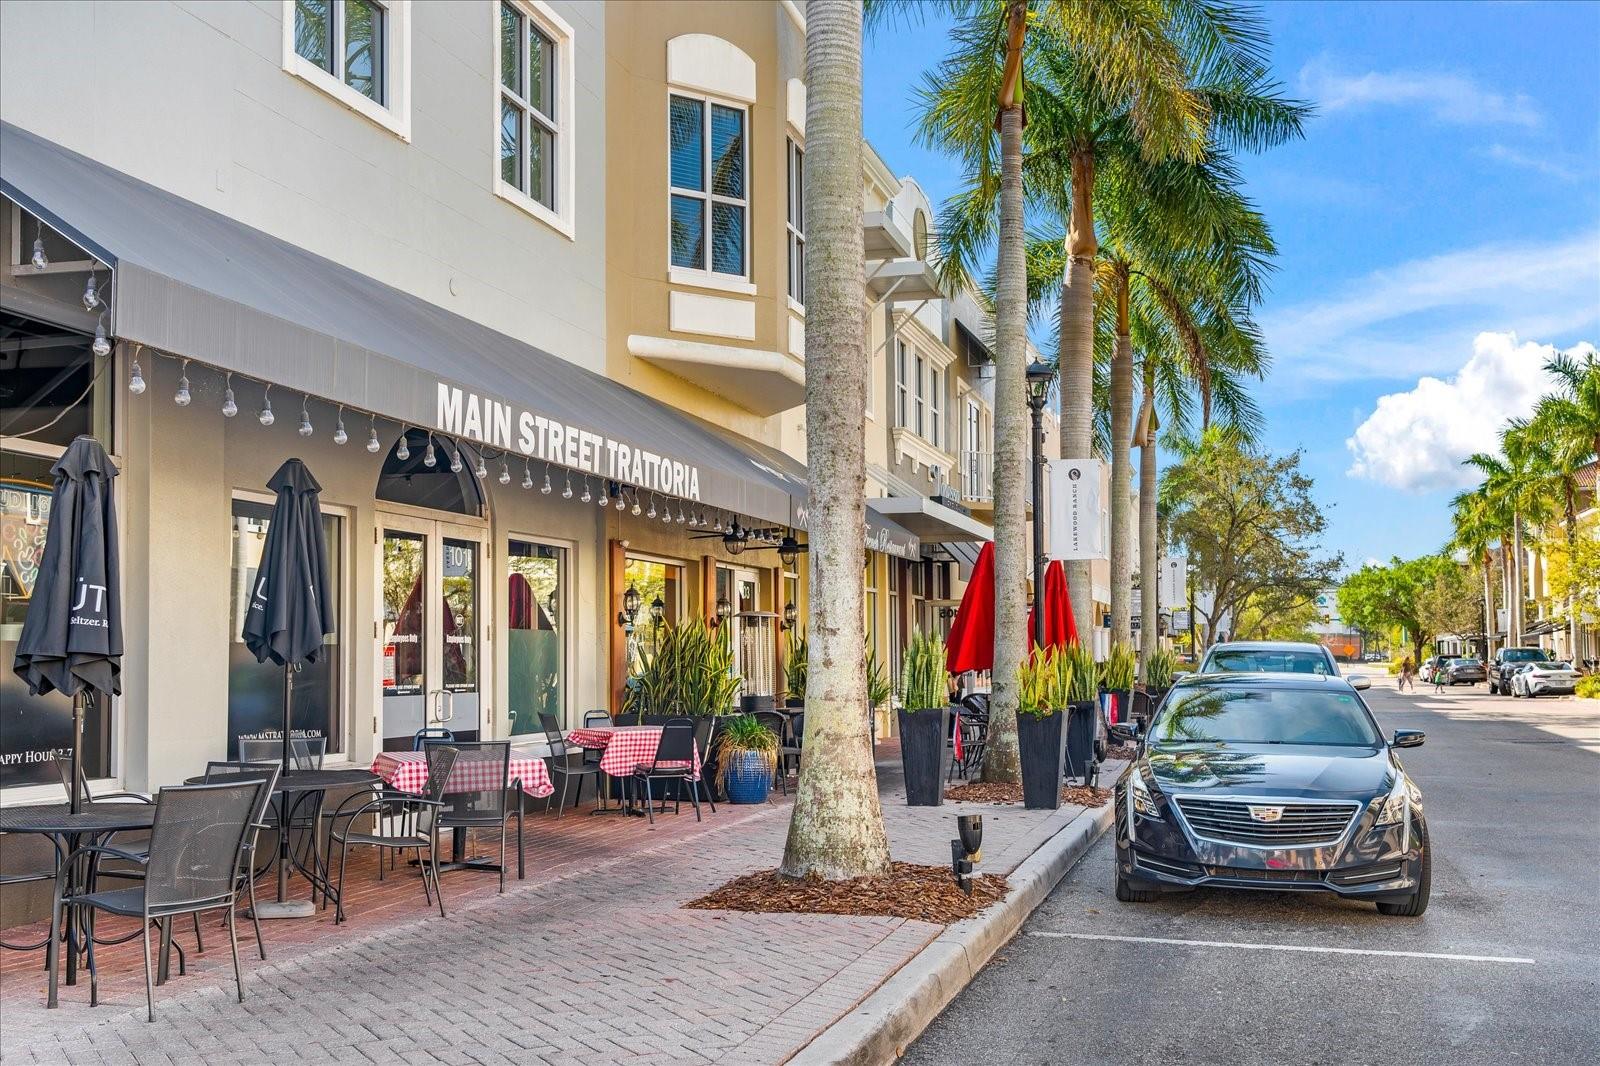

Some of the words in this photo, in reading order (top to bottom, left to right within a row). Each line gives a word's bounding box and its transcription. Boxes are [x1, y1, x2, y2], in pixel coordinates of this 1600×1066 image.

[437, 382, 512, 449] MAIN
[518, 411, 603, 473] STREET
[607, 439, 701, 501] TRATTORIA
